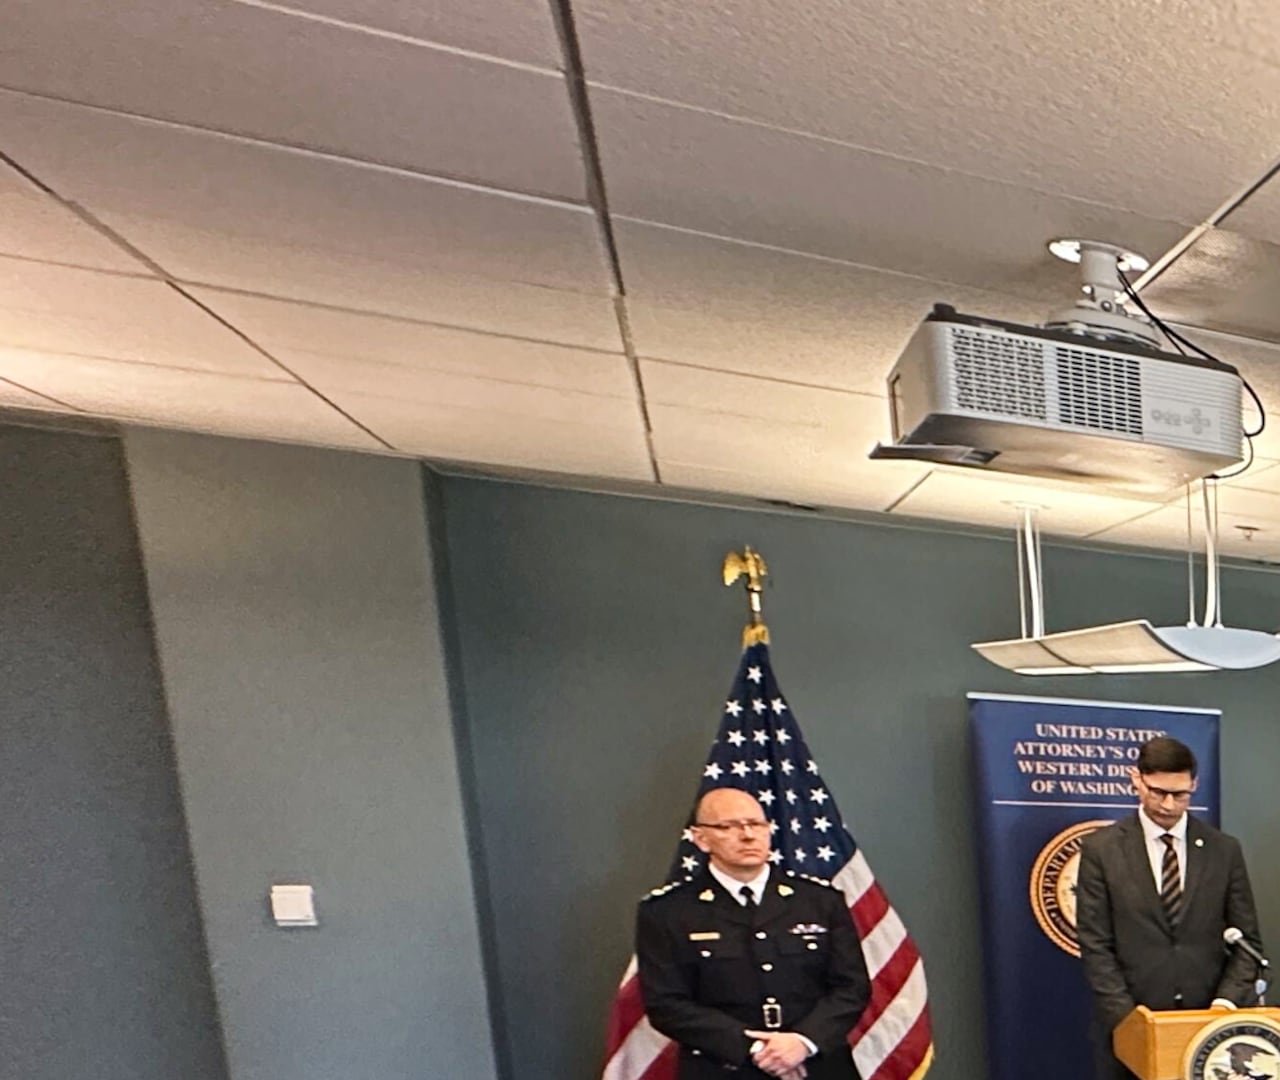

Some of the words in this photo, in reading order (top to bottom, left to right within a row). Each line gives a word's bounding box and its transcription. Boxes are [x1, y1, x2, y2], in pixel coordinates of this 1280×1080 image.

[1035, 723, 1102, 738] UNITED
[1014, 741, 1124, 759] ATTORNEY'S
[1018, 760, 1104, 776] WESTERN
[1031, 780, 1056, 793] OF
[1060, 781, 1138, 796] WASHING
